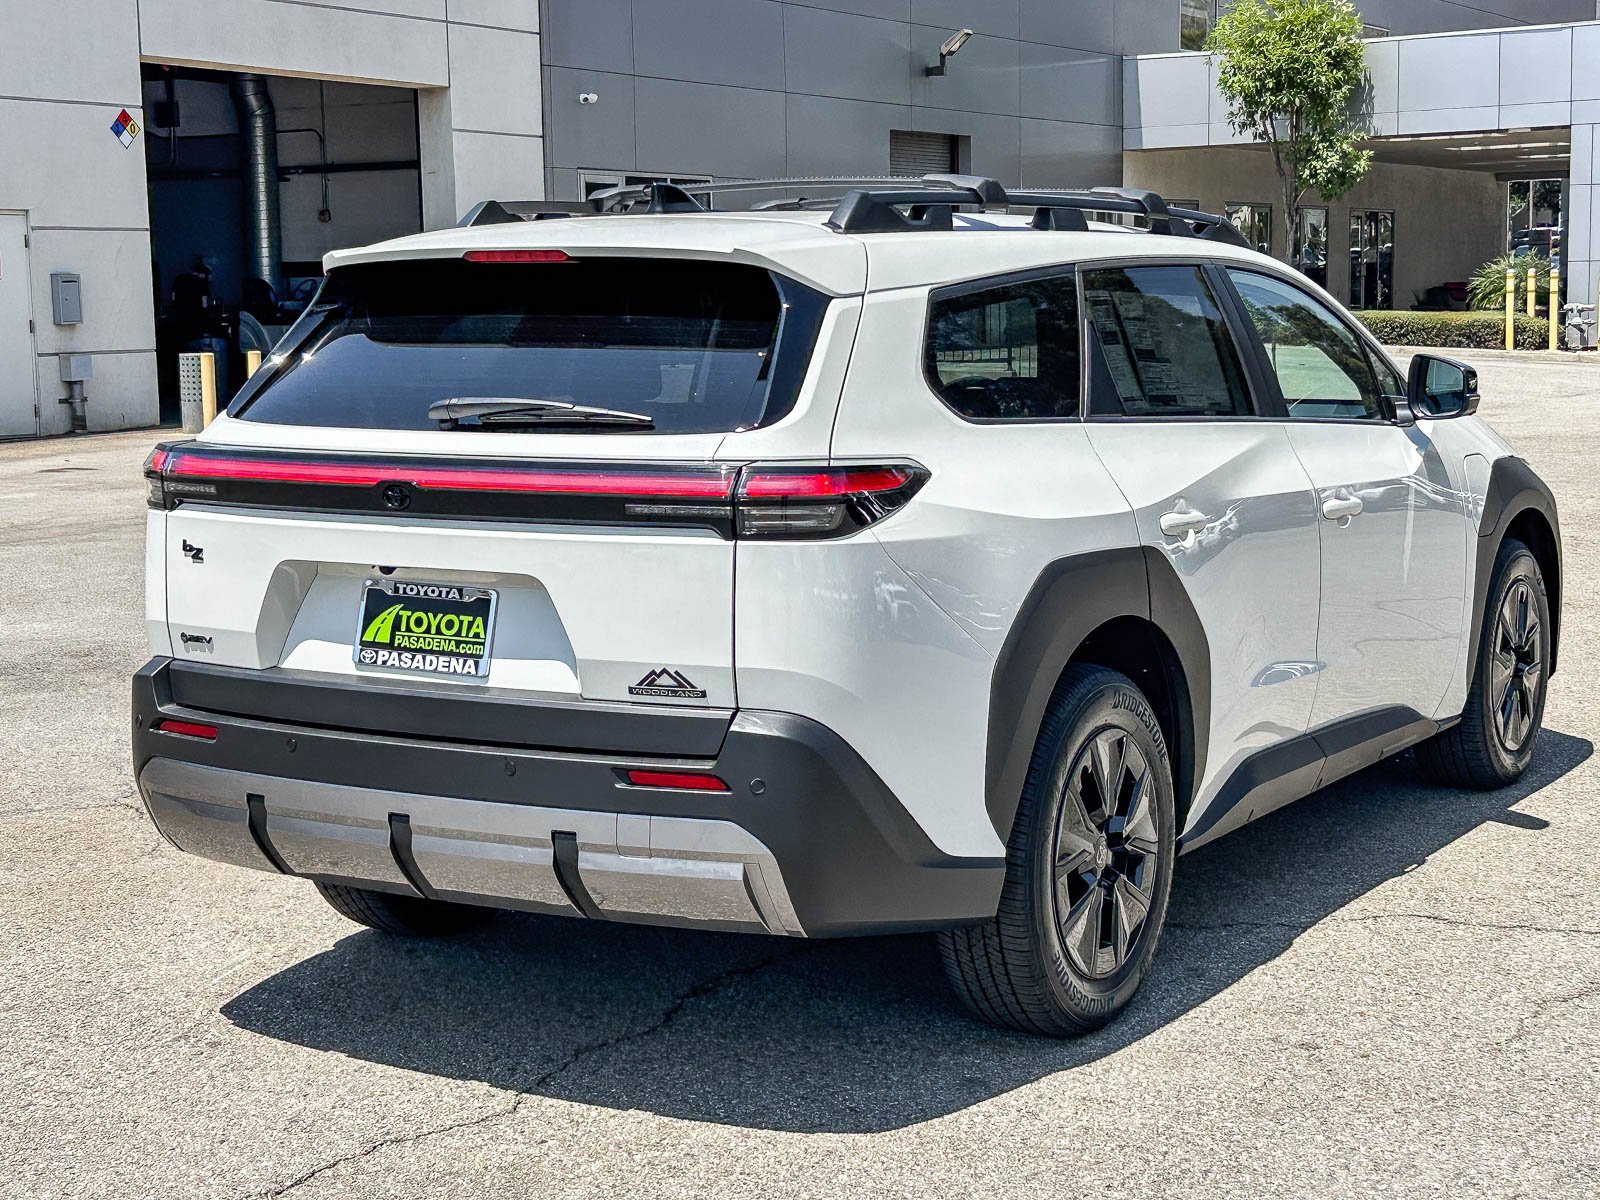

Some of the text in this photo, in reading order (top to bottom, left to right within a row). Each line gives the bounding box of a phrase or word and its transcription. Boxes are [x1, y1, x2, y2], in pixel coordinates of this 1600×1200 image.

[130, 123, 136, 134] 0
[396, 583, 460, 599] TOYOTA
[398, 610, 486, 639] TOYOTA
[394, 635, 484, 655] PASADENA.com
[376, 650, 477, 675] PASADENA
[632, 688, 702, 698] WOODLAND
[1112, 690, 1167, 765] BRIDGESTONE
